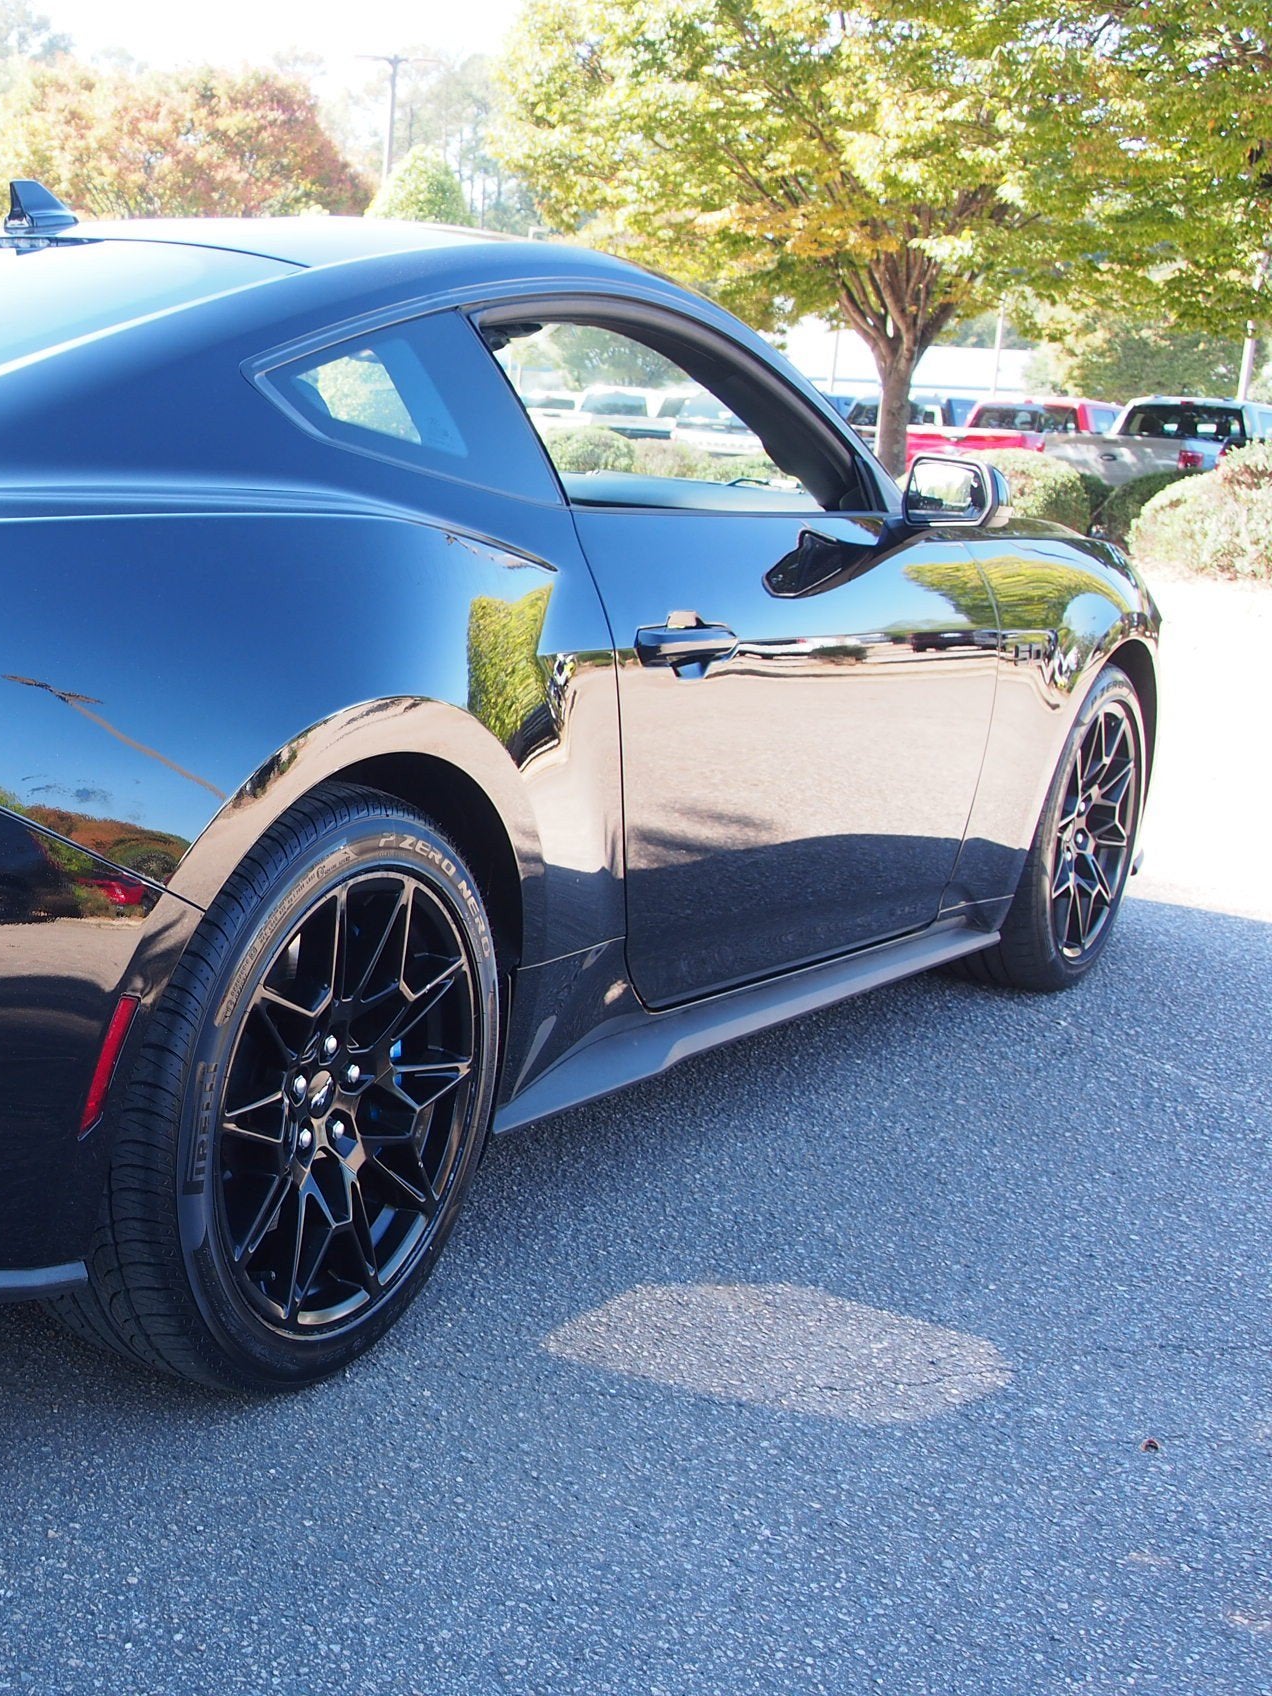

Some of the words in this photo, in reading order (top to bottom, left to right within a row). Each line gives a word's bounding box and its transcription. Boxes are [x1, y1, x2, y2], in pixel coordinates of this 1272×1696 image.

[379, 832, 395, 847] P
[399, 834, 456, 877] ZERO
[457, 880, 490, 957] NERO
[183, 1061, 218, 1195] PIRELLI
